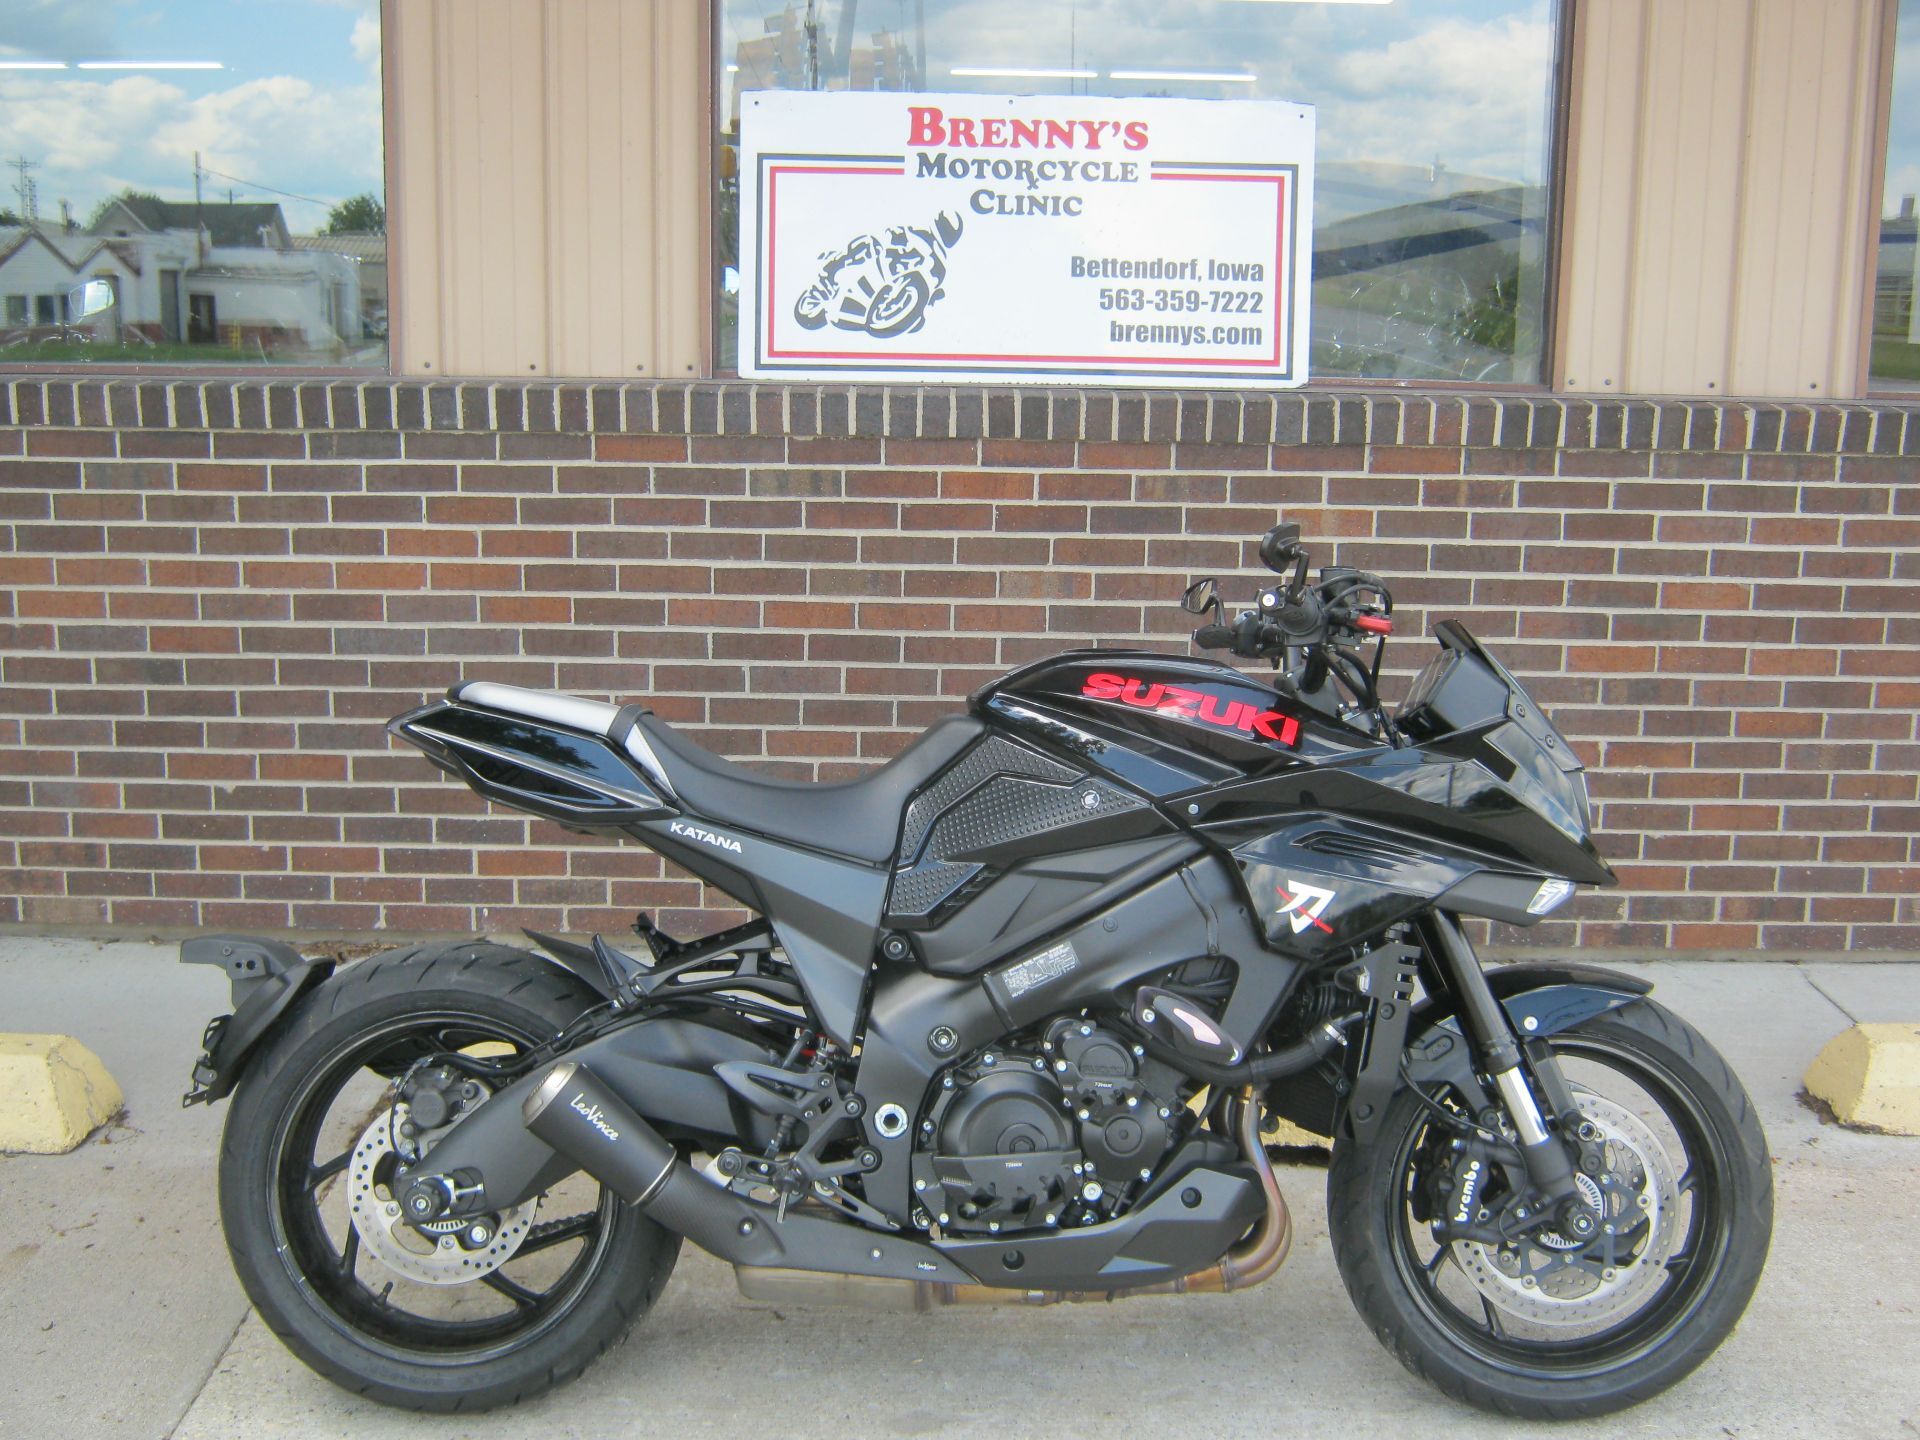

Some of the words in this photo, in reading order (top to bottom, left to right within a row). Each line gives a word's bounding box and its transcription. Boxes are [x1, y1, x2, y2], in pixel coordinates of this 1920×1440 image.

[907, 106, 1149, 150] BRENNY'S
[916, 152, 1139, 189] MOTORCYCLE
[970, 189, 1083, 216] CLINIC
[1071, 256, 1202, 282] Bettendorf,
[1208, 259, 1264, 282] Iowa
[1099, 288, 1264, 313] 563-359-7222
[1110, 320, 1262, 346] brennys.com
[1083, 673, 1299, 746] SUZUKI
[670, 822, 742, 853] KATANA
[1454, 1160, 1480, 1222] brembo
